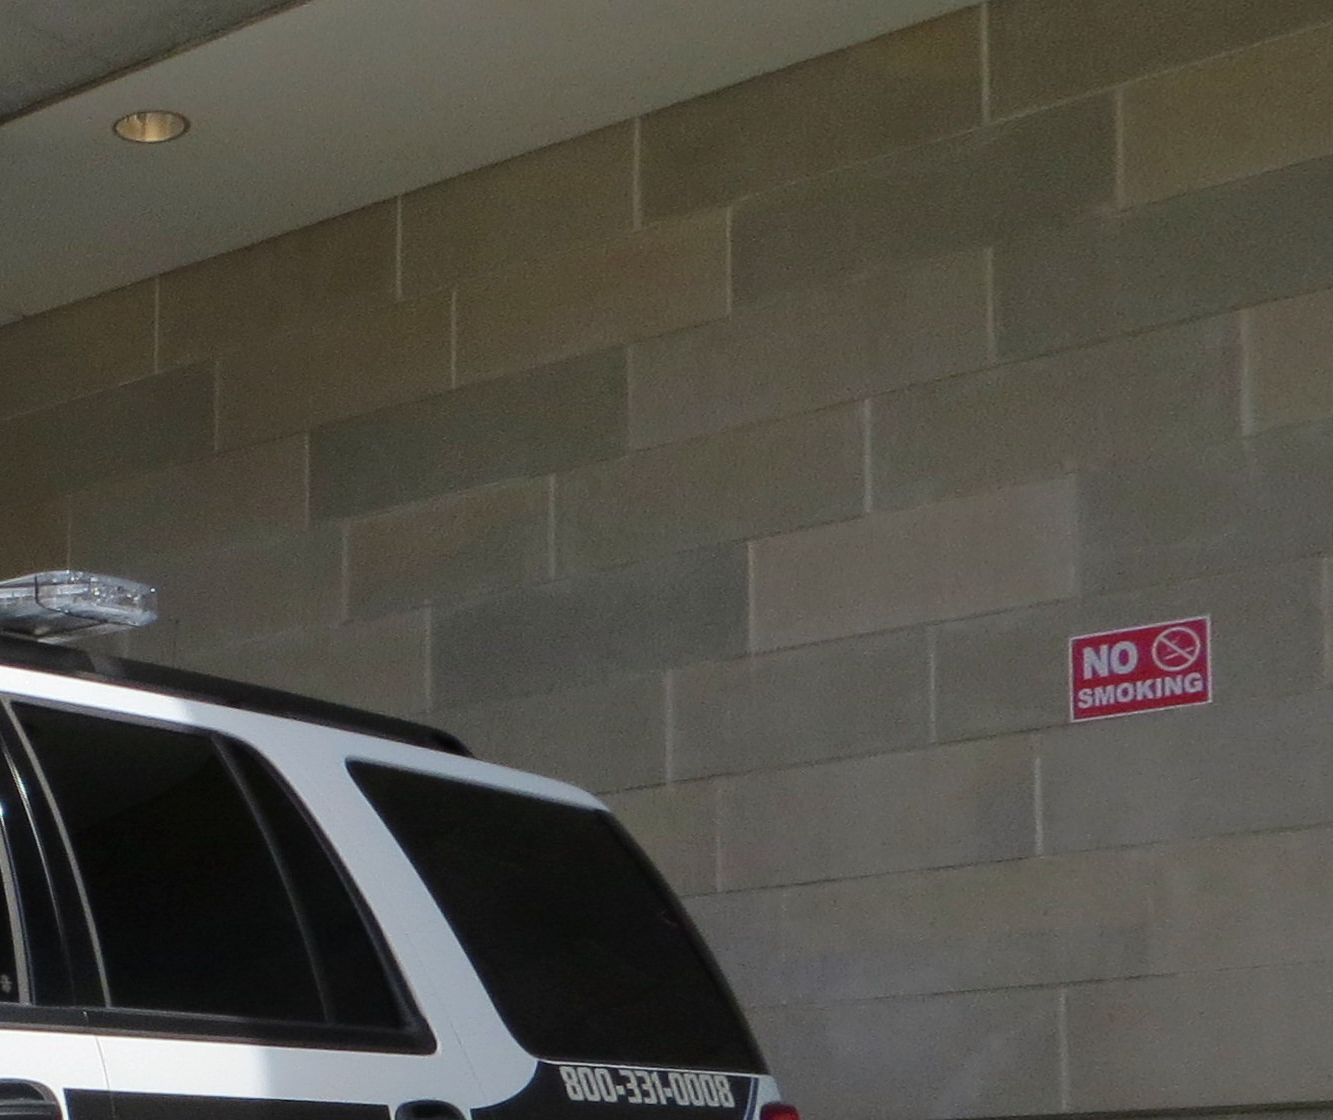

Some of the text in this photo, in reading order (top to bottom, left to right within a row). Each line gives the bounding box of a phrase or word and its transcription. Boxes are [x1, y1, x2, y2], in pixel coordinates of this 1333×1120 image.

[1082, 640, 1139, 681] NO
[1076, 671, 1204, 710] SMOKING
[559, 1066, 736, 1108] 800-331-0008
